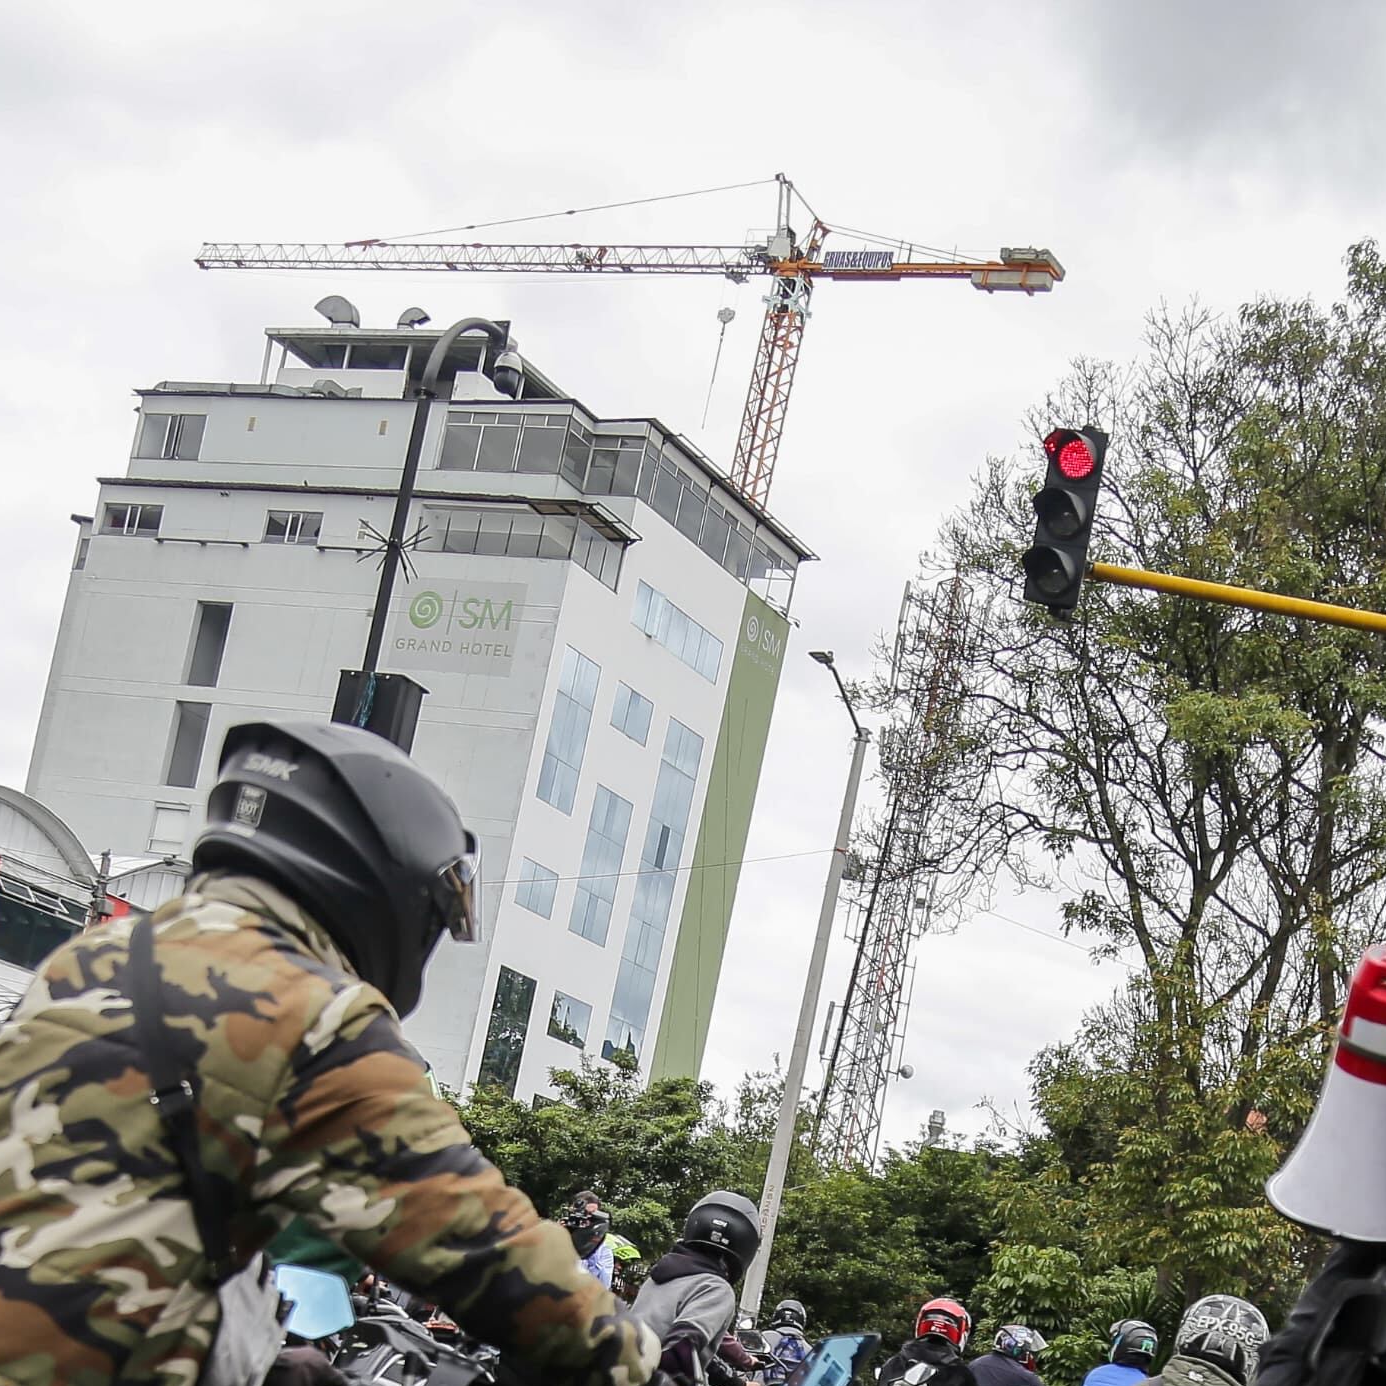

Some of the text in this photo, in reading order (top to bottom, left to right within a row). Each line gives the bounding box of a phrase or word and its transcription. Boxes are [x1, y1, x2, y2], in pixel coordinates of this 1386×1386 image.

[458, 597, 513, 632] SM
[395, 638, 512, 658] GRAND HOTEL
[762, 629, 782, 660] SM
[1197, 1316, 1255, 1346] EPX-95G
